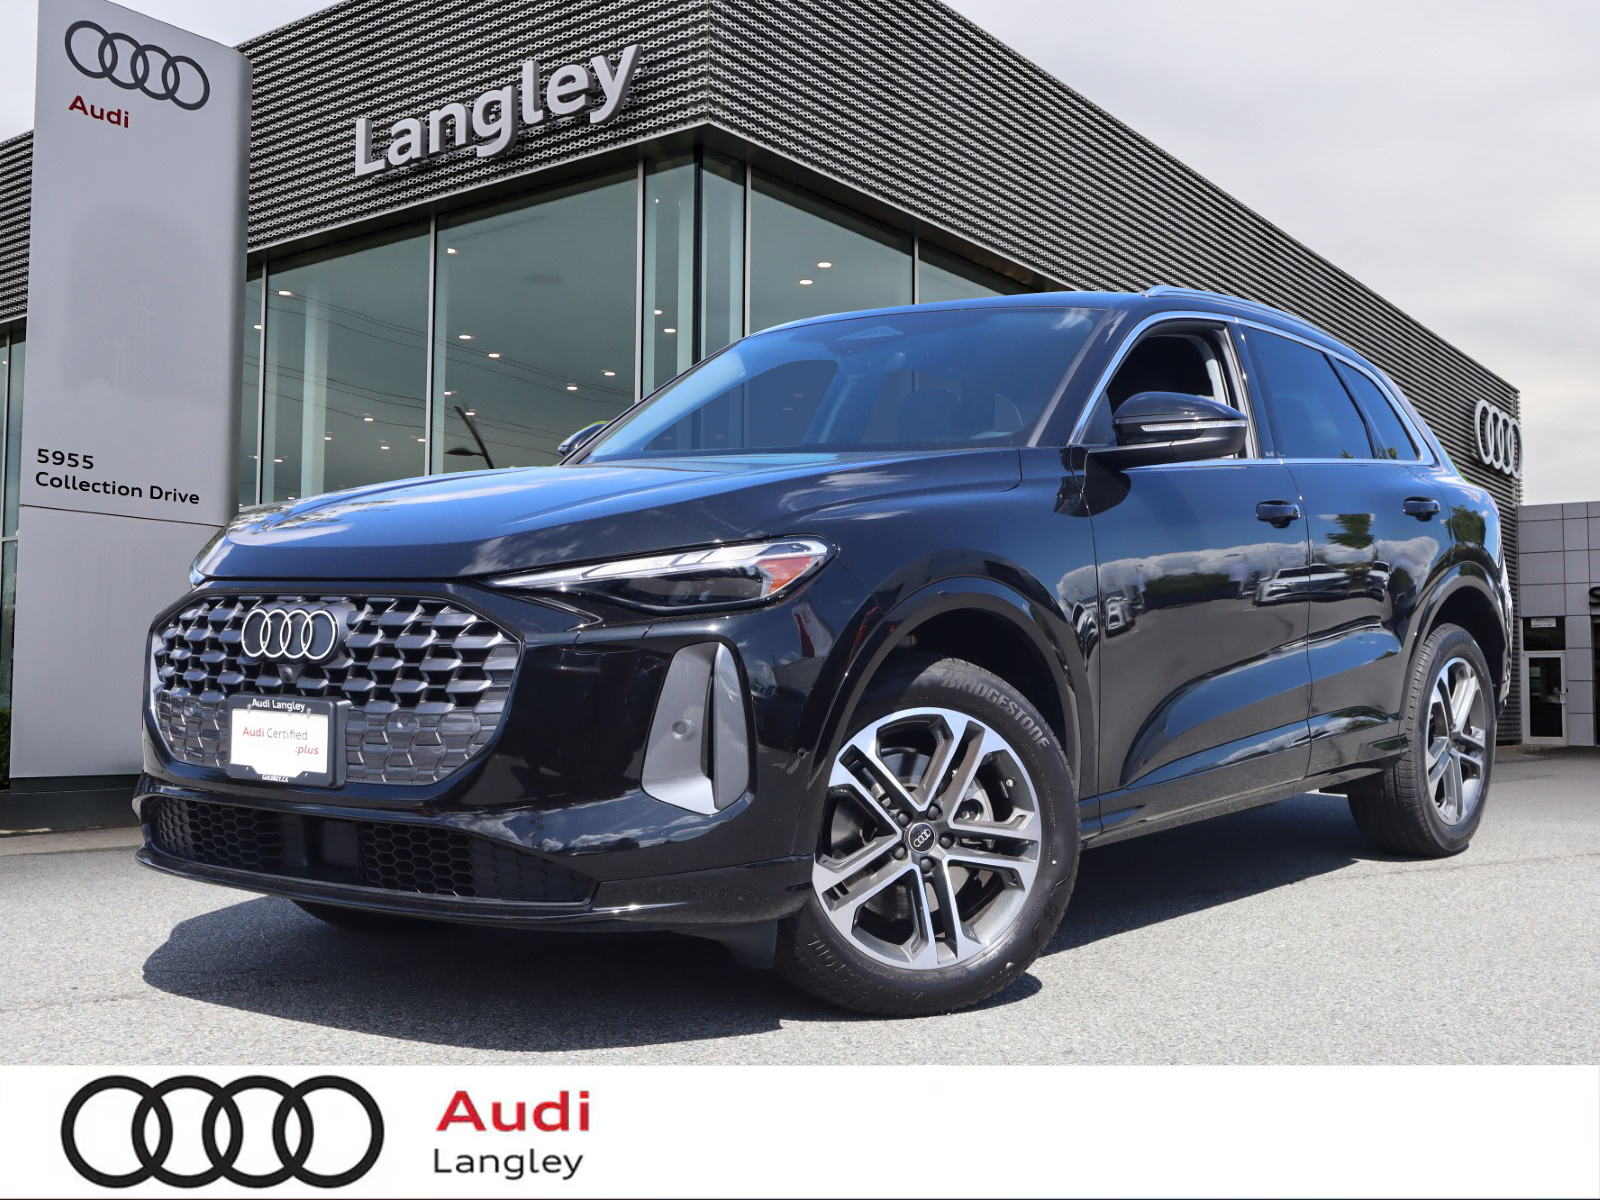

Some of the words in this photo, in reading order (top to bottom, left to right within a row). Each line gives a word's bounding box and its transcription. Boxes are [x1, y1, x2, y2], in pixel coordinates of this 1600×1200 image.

[69, 95, 129, 128] Audi
[354, 44, 642, 176] Langley
[37, 448, 94, 470] 5955
[35, 471, 143, 498] Collection
[149, 485, 200, 505] Drive
[251, 698, 270, 708] Audi
[271, 699, 306, 713] Langley
[941, 673, 1050, 748] BRIDGESTONE
[242, 726, 265, 738] Audi
[266, 727, 308, 741] Certified
